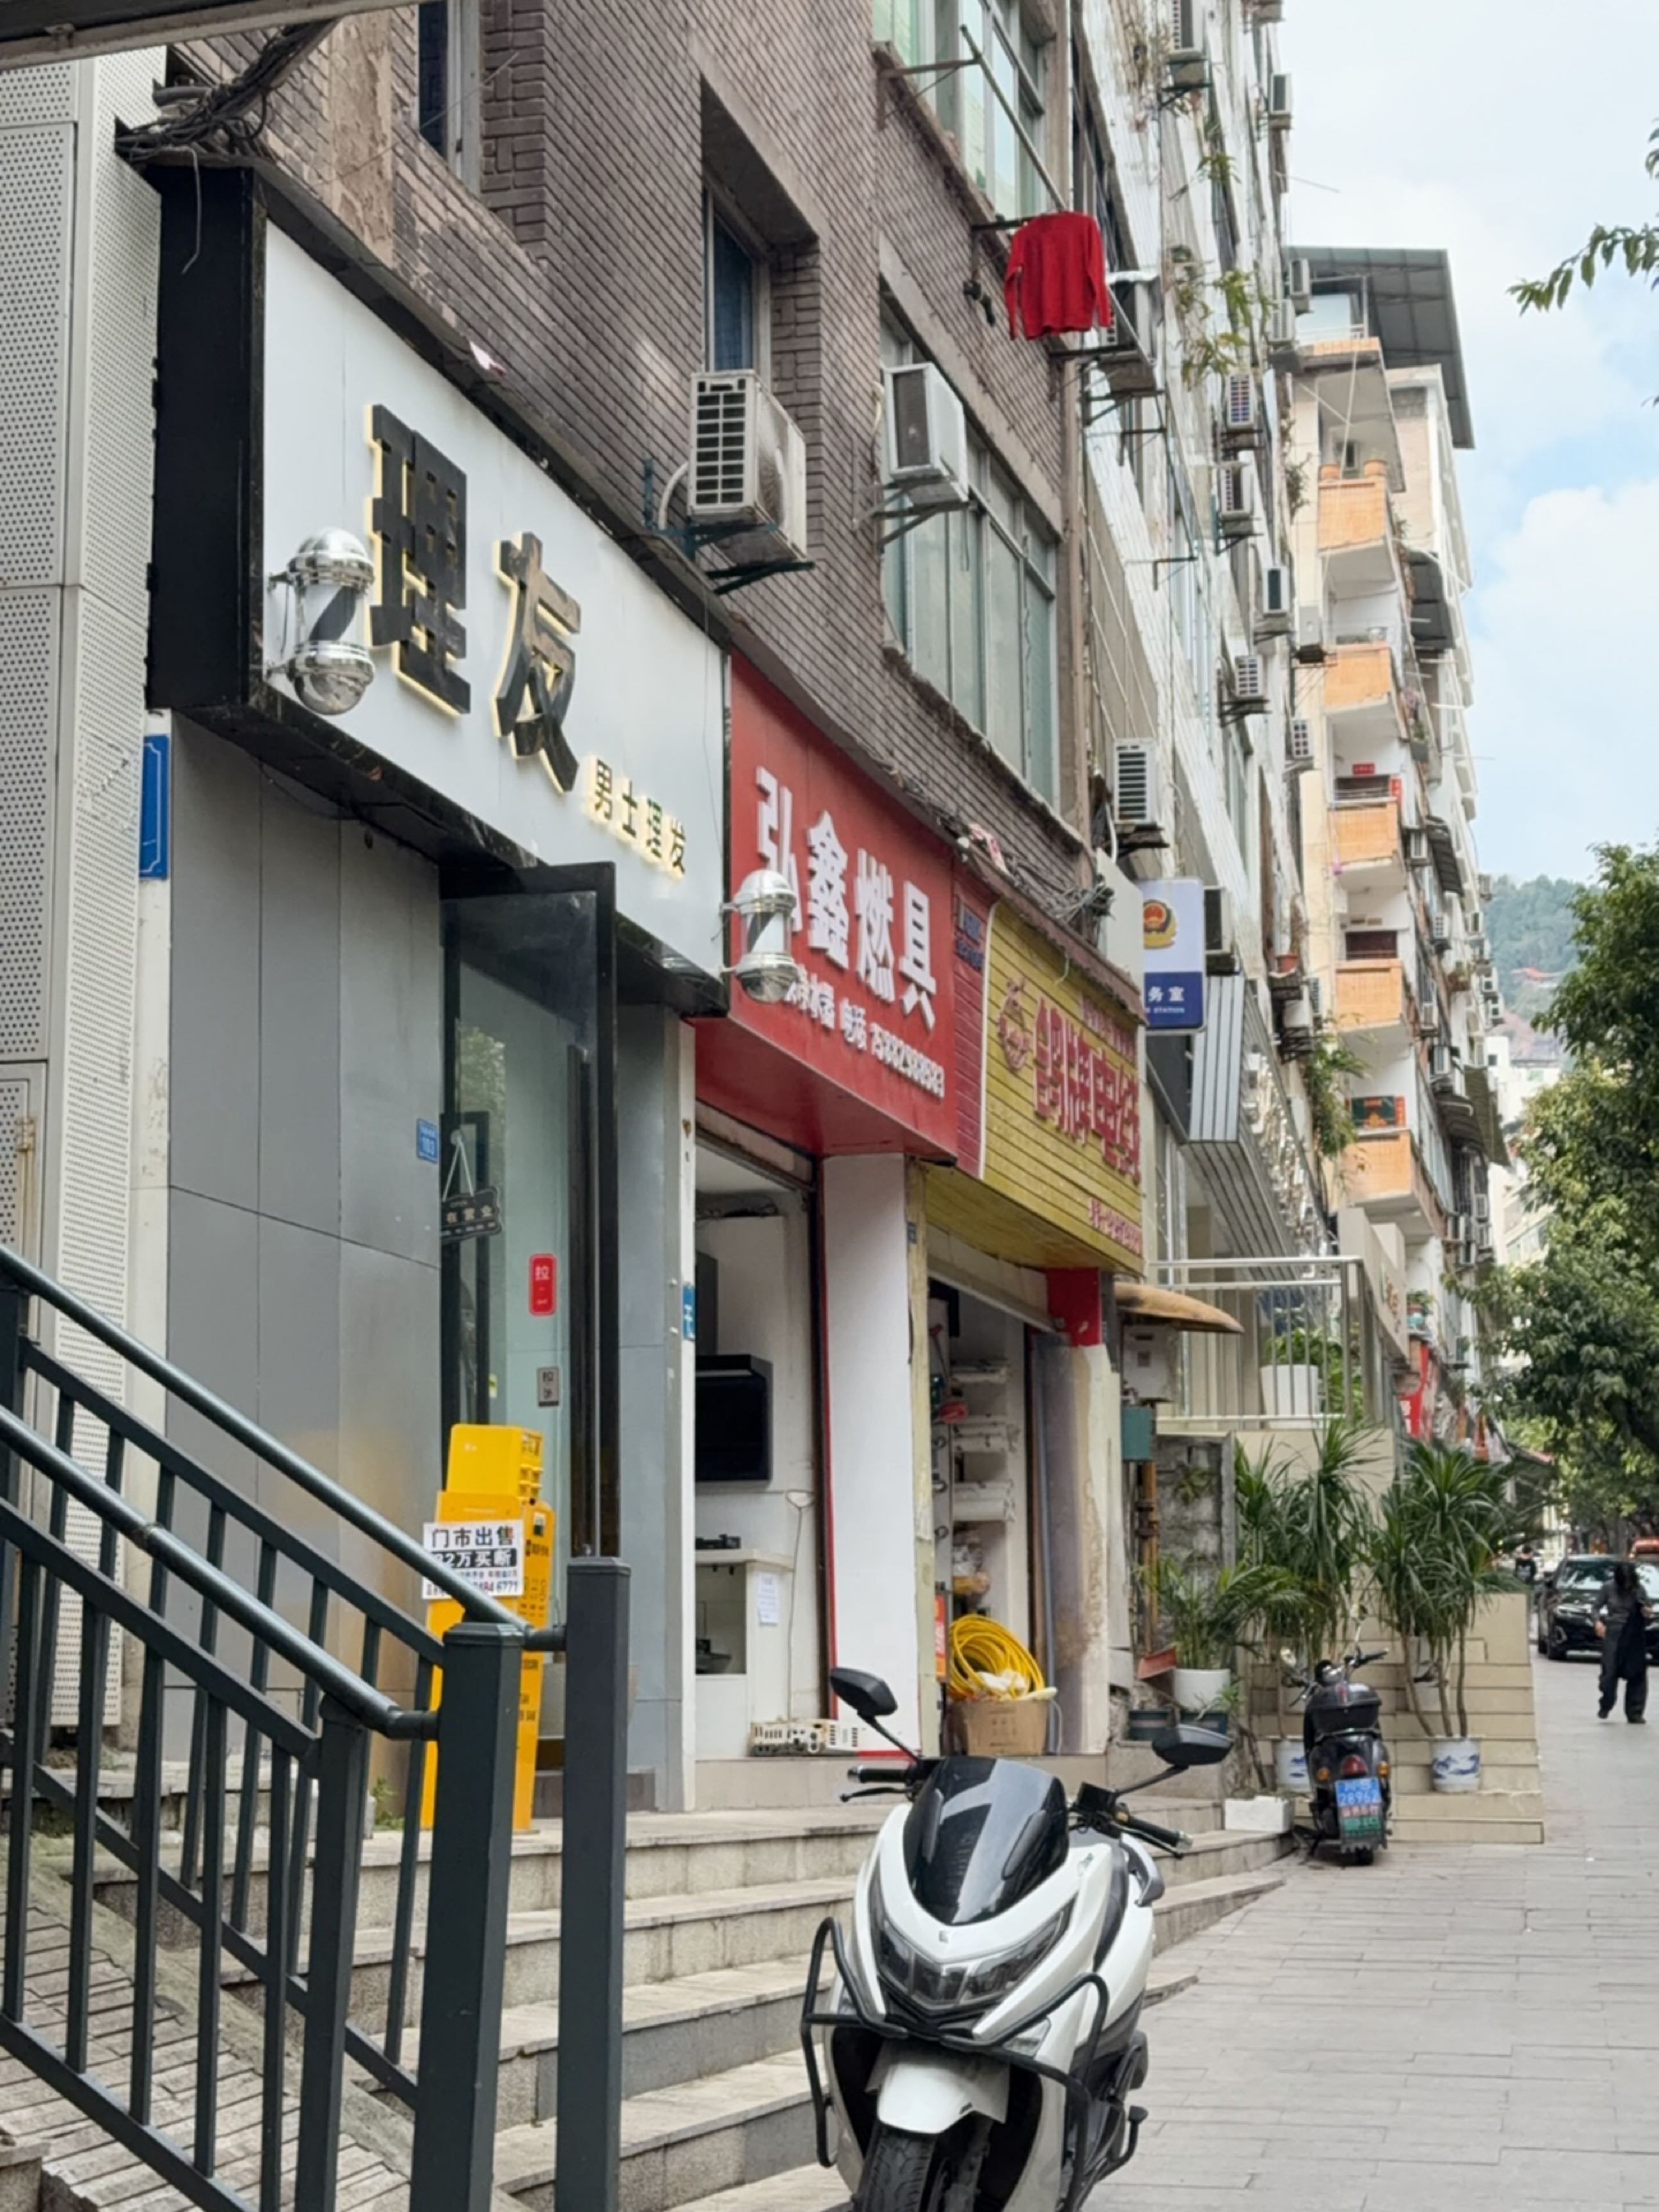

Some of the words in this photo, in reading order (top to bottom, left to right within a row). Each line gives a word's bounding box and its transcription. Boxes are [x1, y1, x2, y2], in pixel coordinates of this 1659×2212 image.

[591, 757, 686, 878] 男士理发
[433, 1526, 514, 1548] 门市出售
